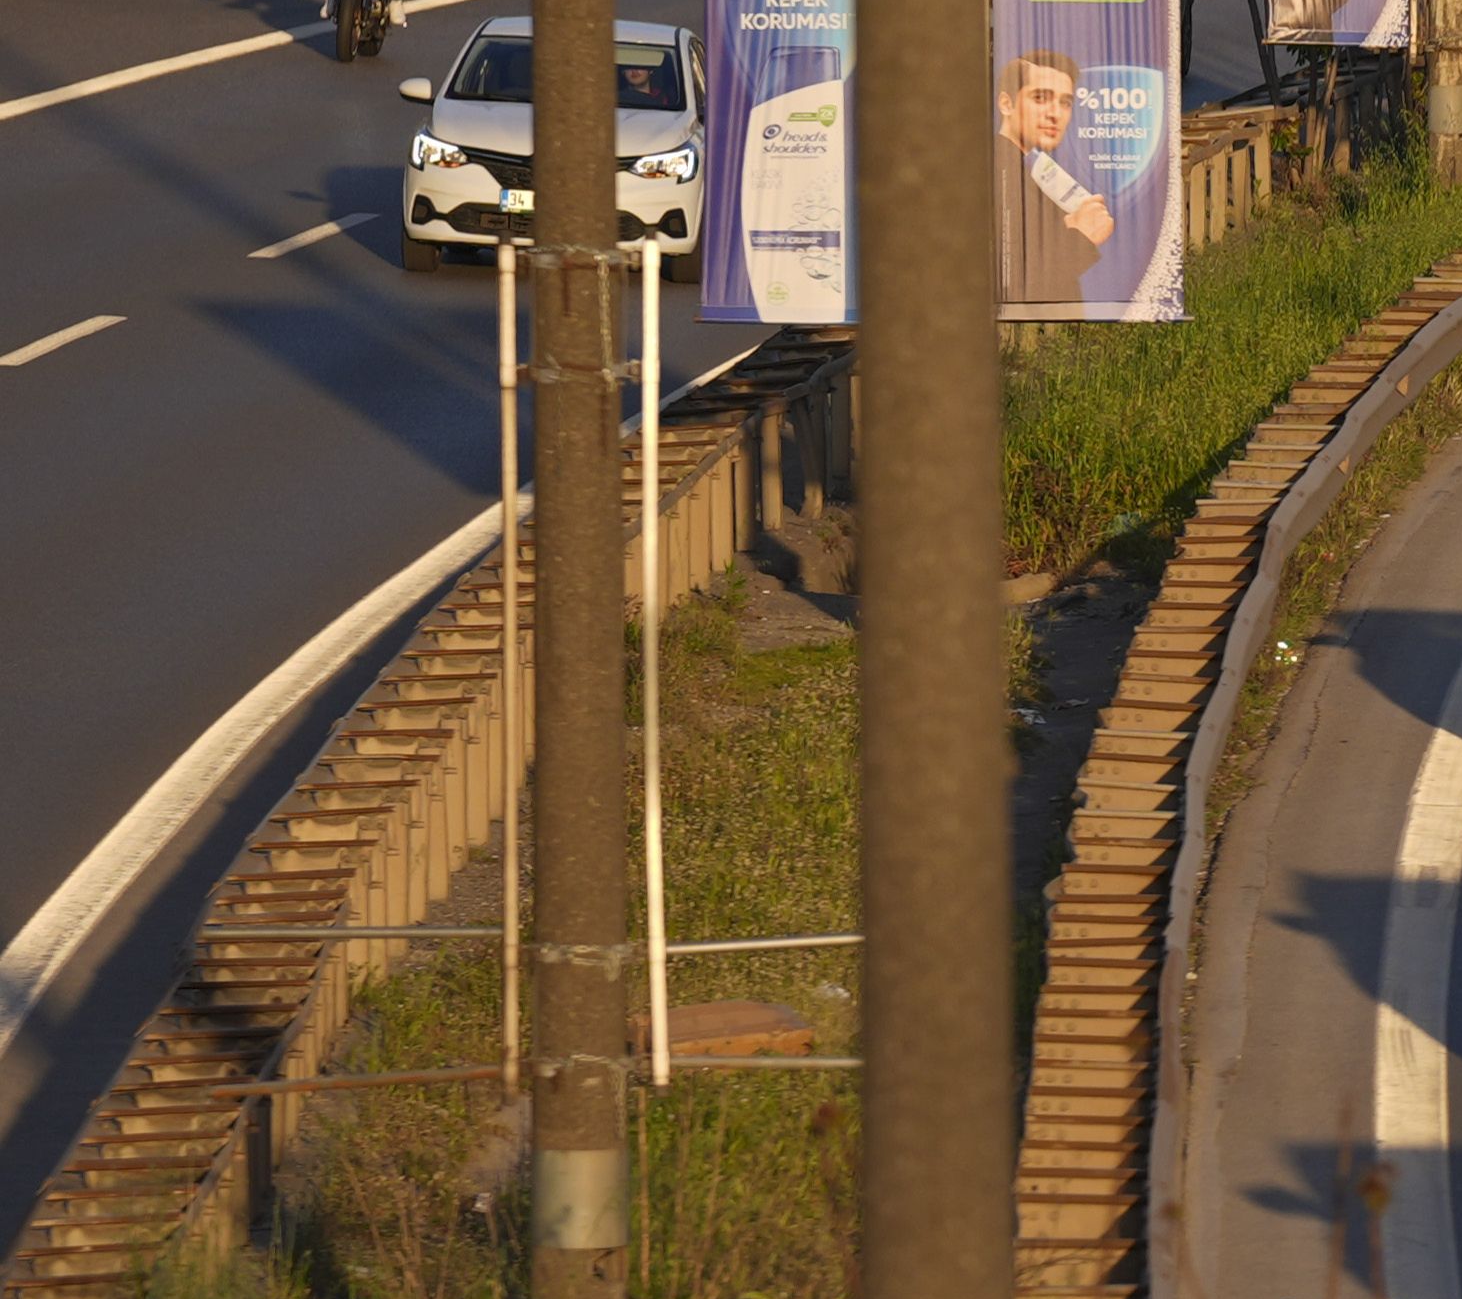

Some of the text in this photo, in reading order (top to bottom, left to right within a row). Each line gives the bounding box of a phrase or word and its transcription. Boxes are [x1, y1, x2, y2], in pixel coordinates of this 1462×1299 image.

[741, 13, 848, 30] KORUMASI
[1076, 88, 1147, 109] %100
[1095, 113, 1135, 124] KEPEK
[1078, 127, 1147, 139] KORUMASI
[763, 143, 827, 155] shoulders
[510, 192, 525, 206] 34
